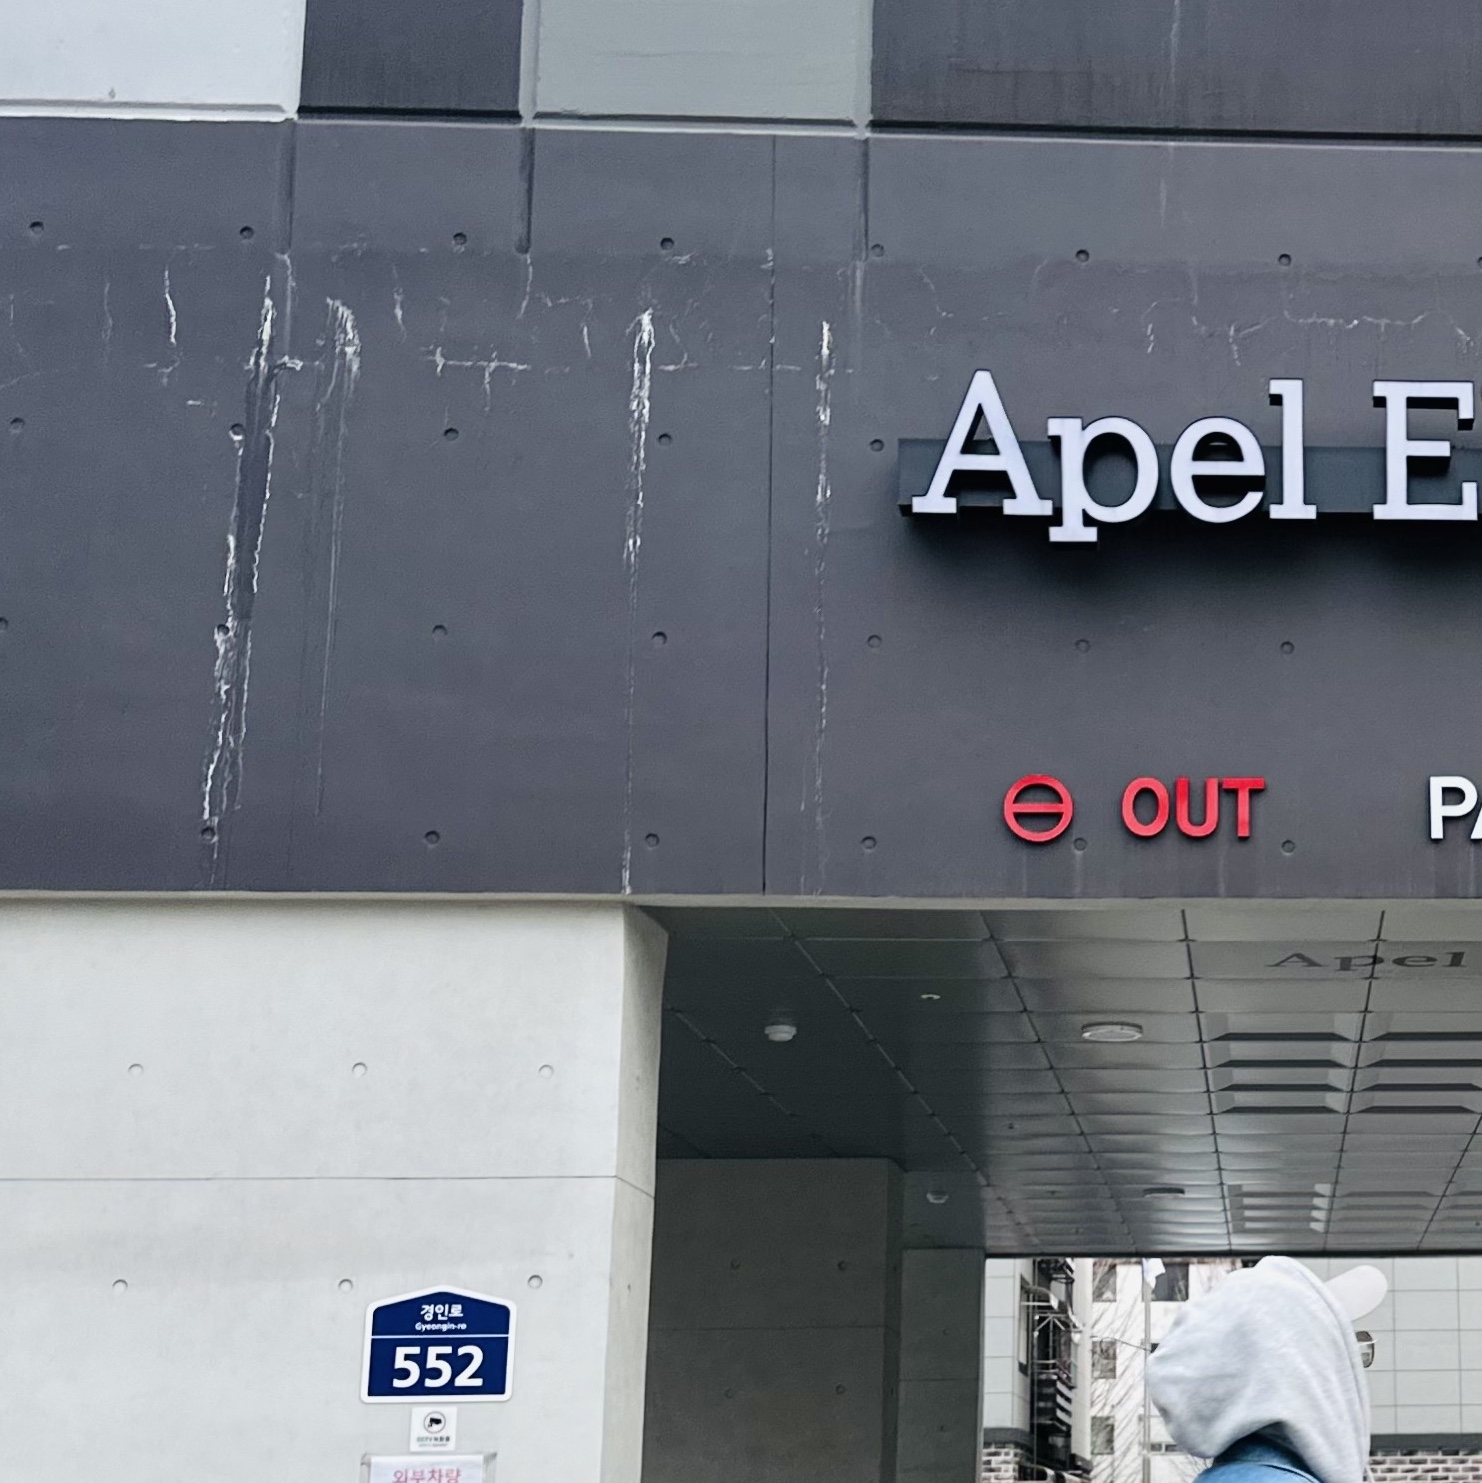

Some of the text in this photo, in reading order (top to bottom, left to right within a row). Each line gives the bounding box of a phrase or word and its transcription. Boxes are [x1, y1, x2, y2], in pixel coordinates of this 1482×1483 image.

[911, 370, 1318, 543] Apel
[1120, 776, 1267, 838] OUT
[1267, 951, 1466, 972] Apel
[415, 1322, 467, 1332] Gyeongin-ro
[420, 1304, 463, 1321] 경인로
[392, 1345, 484, 1388] 552
